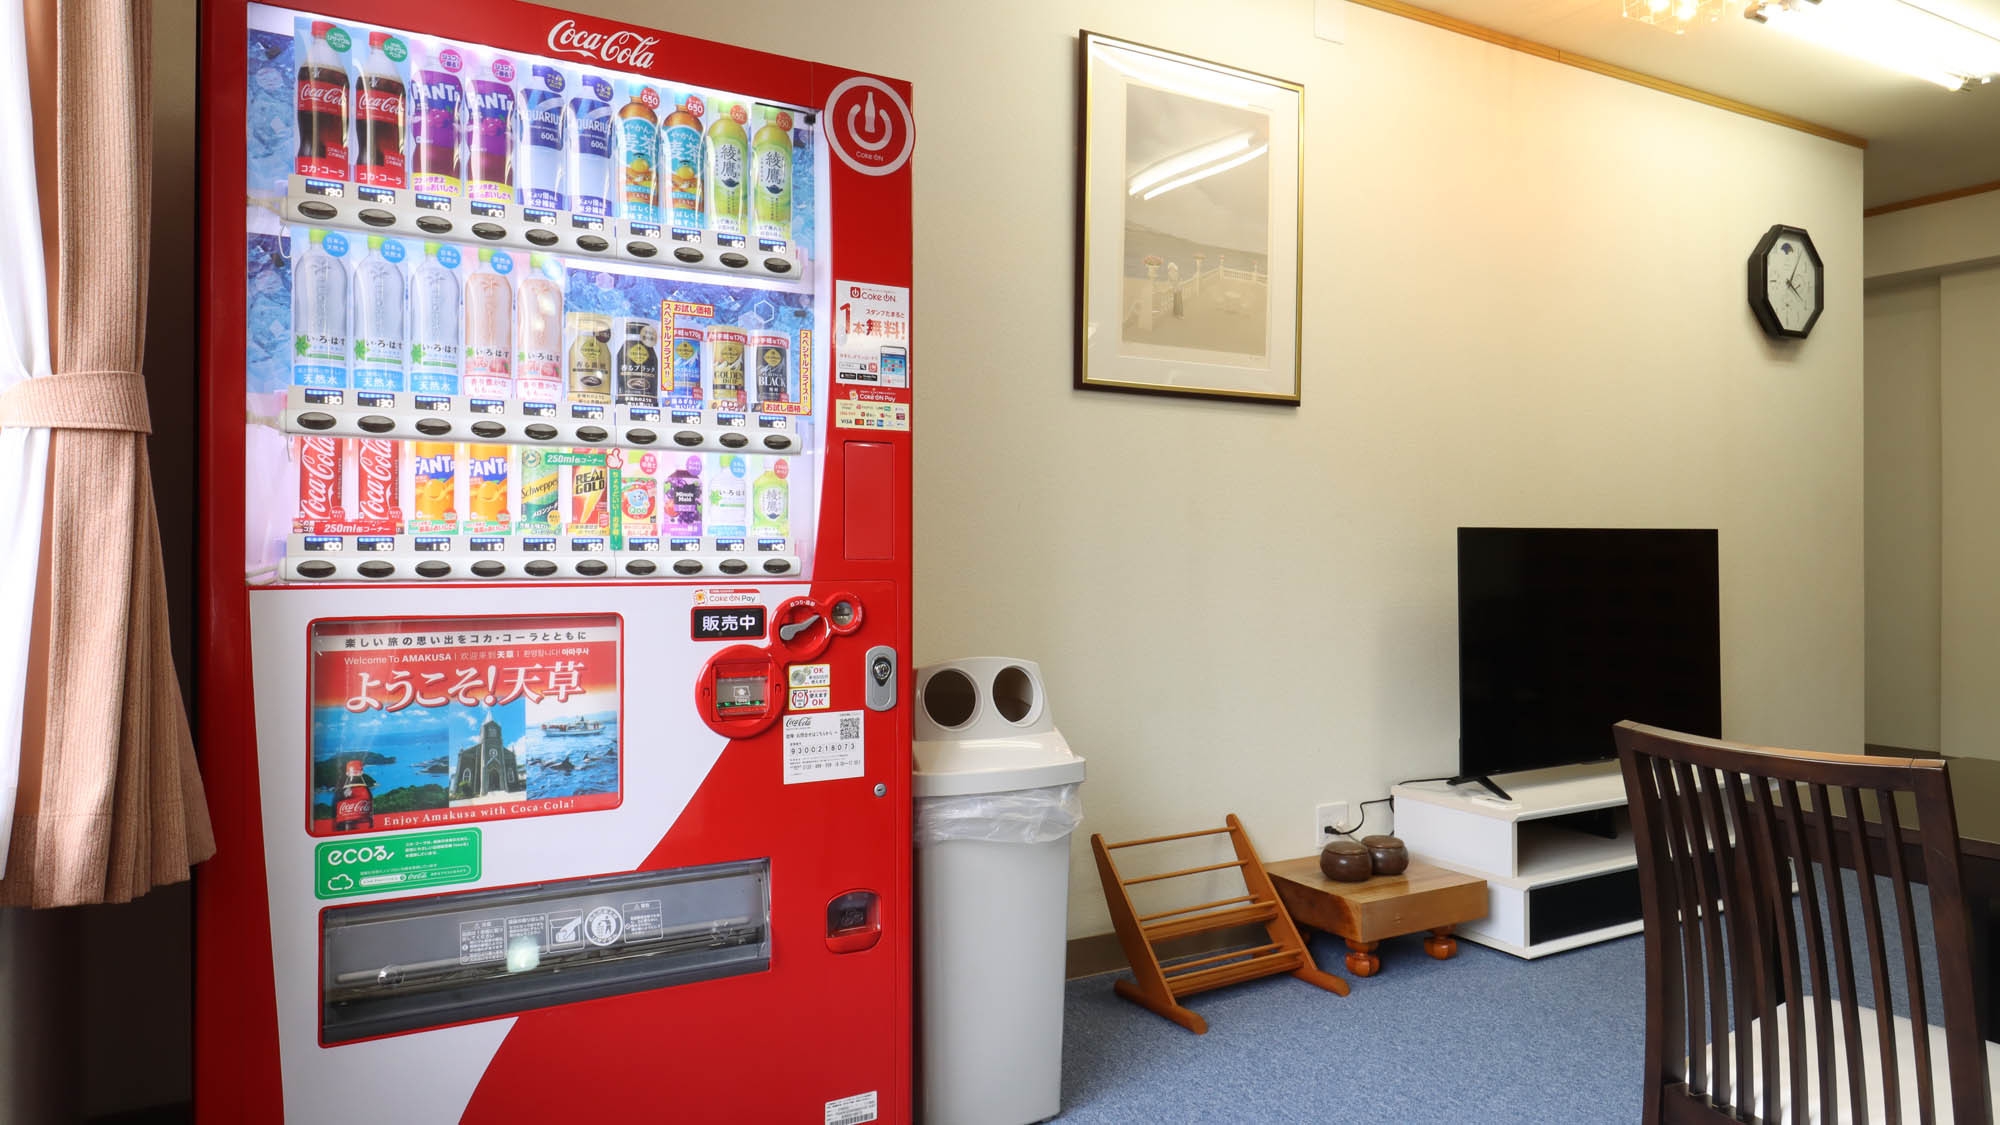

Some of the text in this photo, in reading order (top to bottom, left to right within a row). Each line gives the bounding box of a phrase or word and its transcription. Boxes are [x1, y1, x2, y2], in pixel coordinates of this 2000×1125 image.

[547, 19, 660, 69] Coca-Cola
[642, 94, 658, 106] 650
[687, 103, 703, 113] 650
[720, 144, 738, 178] 綾鷹
[765, 151, 781, 183] 綾鷹
[301, 164, 345, 178] コカ・コーラ
[359, 172, 402, 185] コカ・コーラ
[674, 305, 713, 316] お試し価格
[621, 364, 656, 373] 香るブラック
[303, 374, 338, 385] 天然水
[363, 377, 397, 388] 天然水
[759, 376, 786, 388] BLACK
[419, 381, 451, 392] 天然水
[765, 404, 801, 413] お試し価格
[575, 468, 604, 485] REAL
[575, 480, 605, 495] GOLD
[741, 595, 756, 604] Pay
[702, 614, 756, 633] 販売中
[345, 631, 587, 649] 楽しい旅の思い出をコカ・コーラとともに
[344, 653, 451, 665] Welcome To AMAKUSA
[344, 660, 586, 713] ようこそ!天草
[383, 799, 576, 827] Enjoy Amakusa with Coca-Cola!
